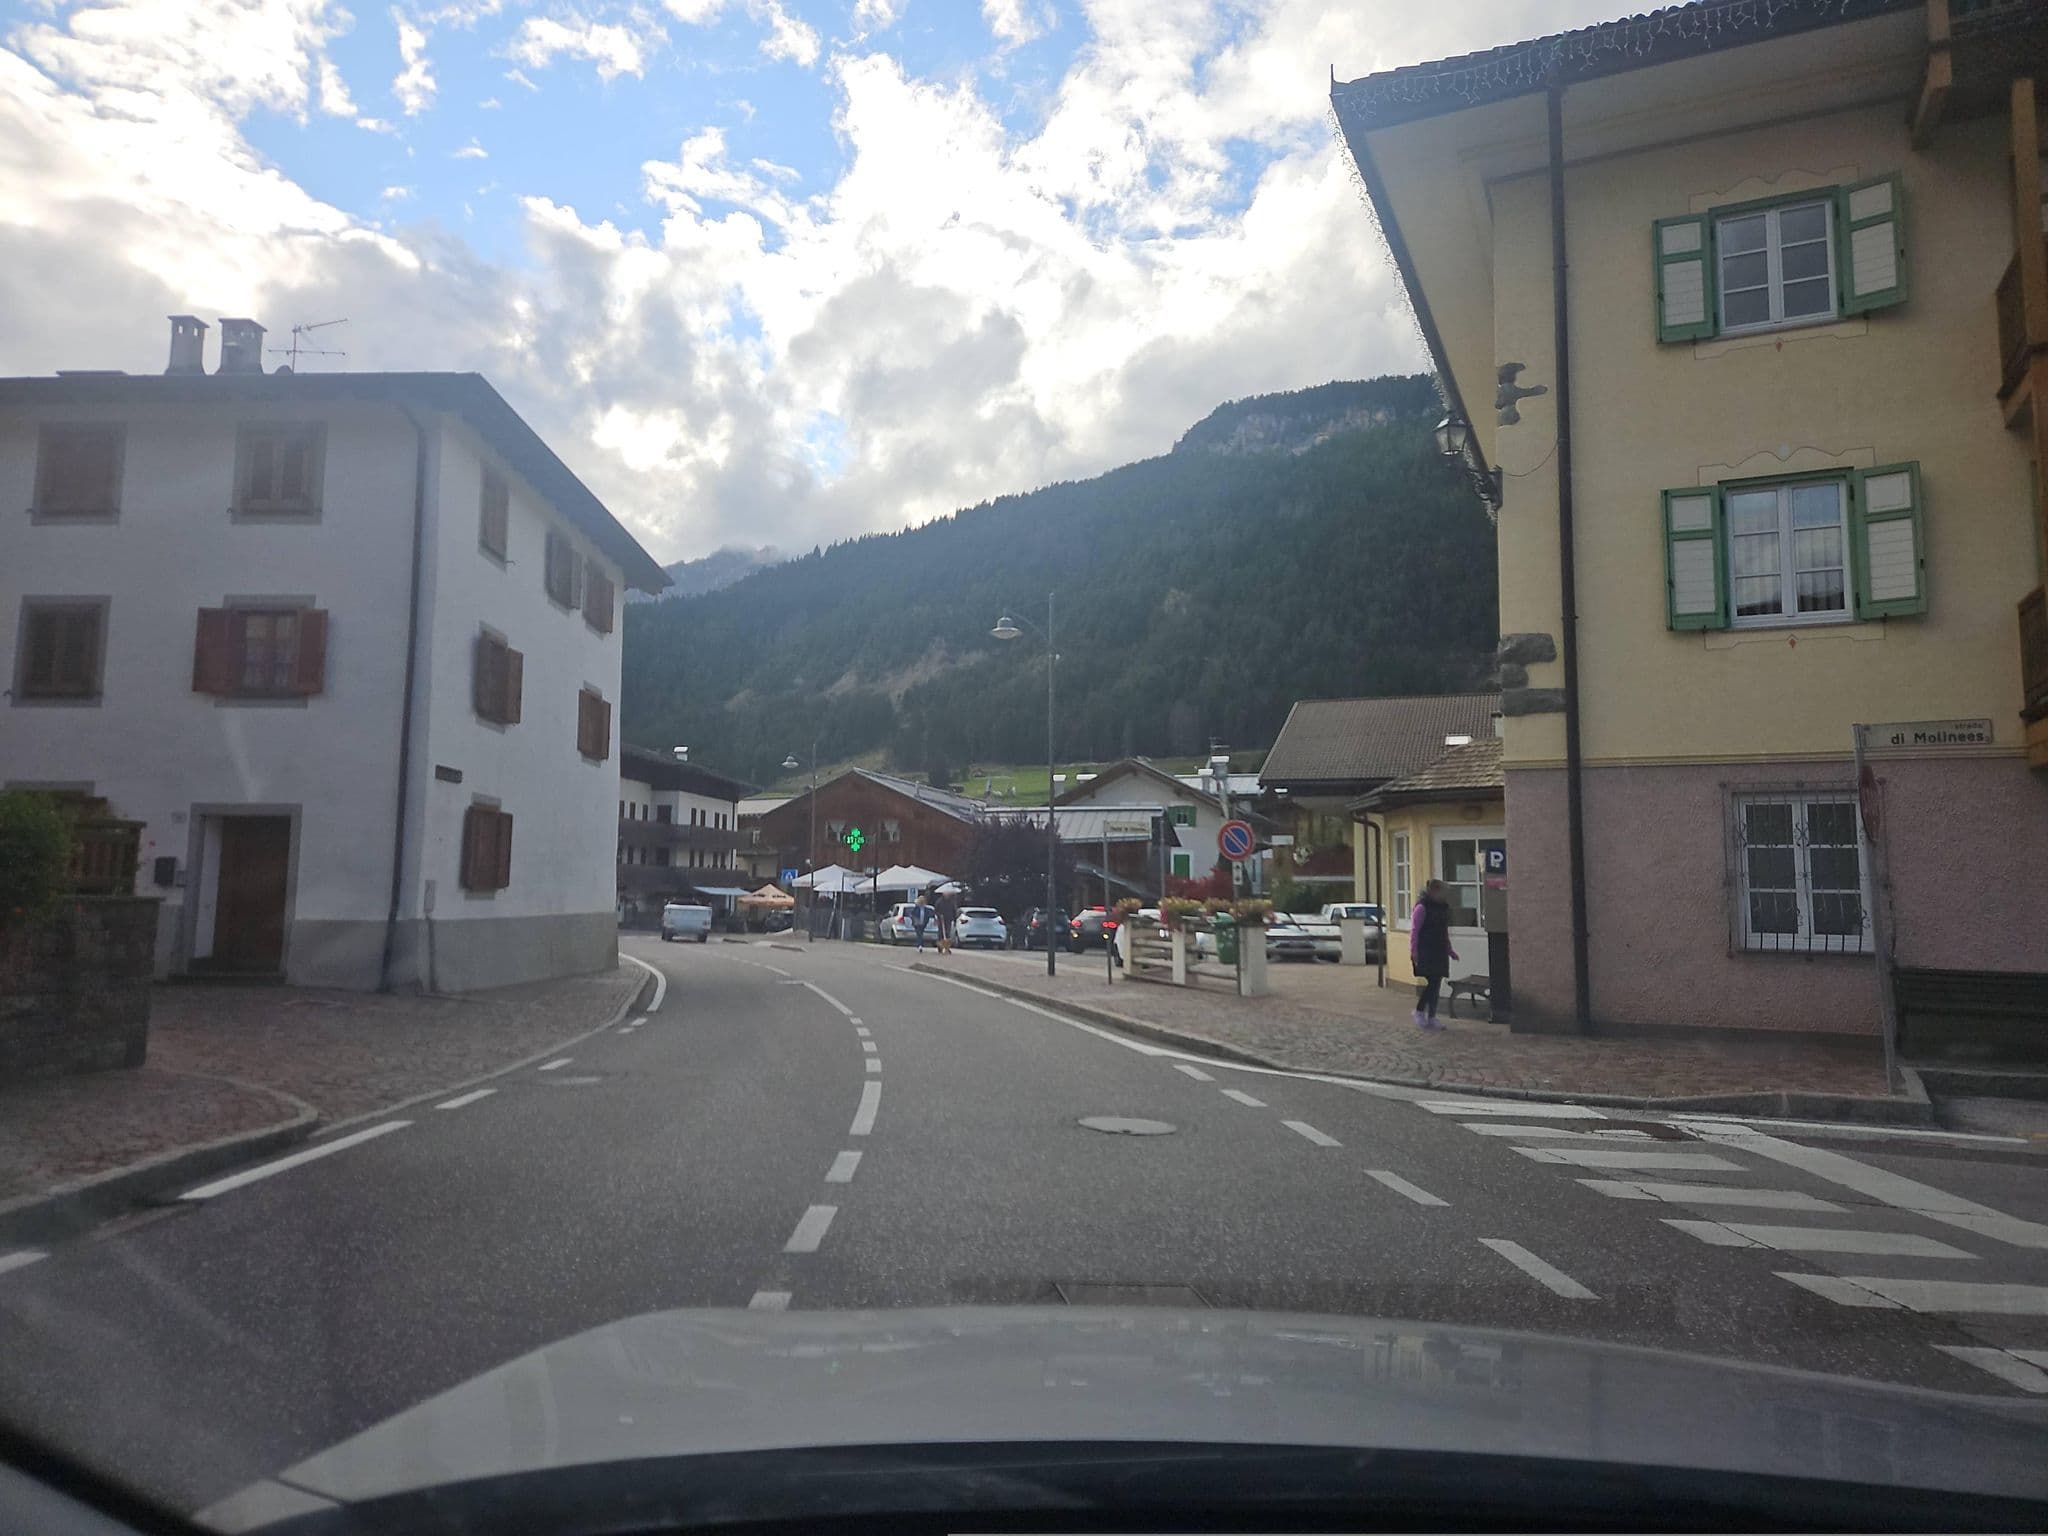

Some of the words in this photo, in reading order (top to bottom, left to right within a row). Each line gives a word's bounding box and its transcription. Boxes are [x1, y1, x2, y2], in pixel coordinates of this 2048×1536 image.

[1891, 733, 1905, 745] di
[1914, 731, 1985, 745] Molinees
[1490, 851, 1504, 868] P
